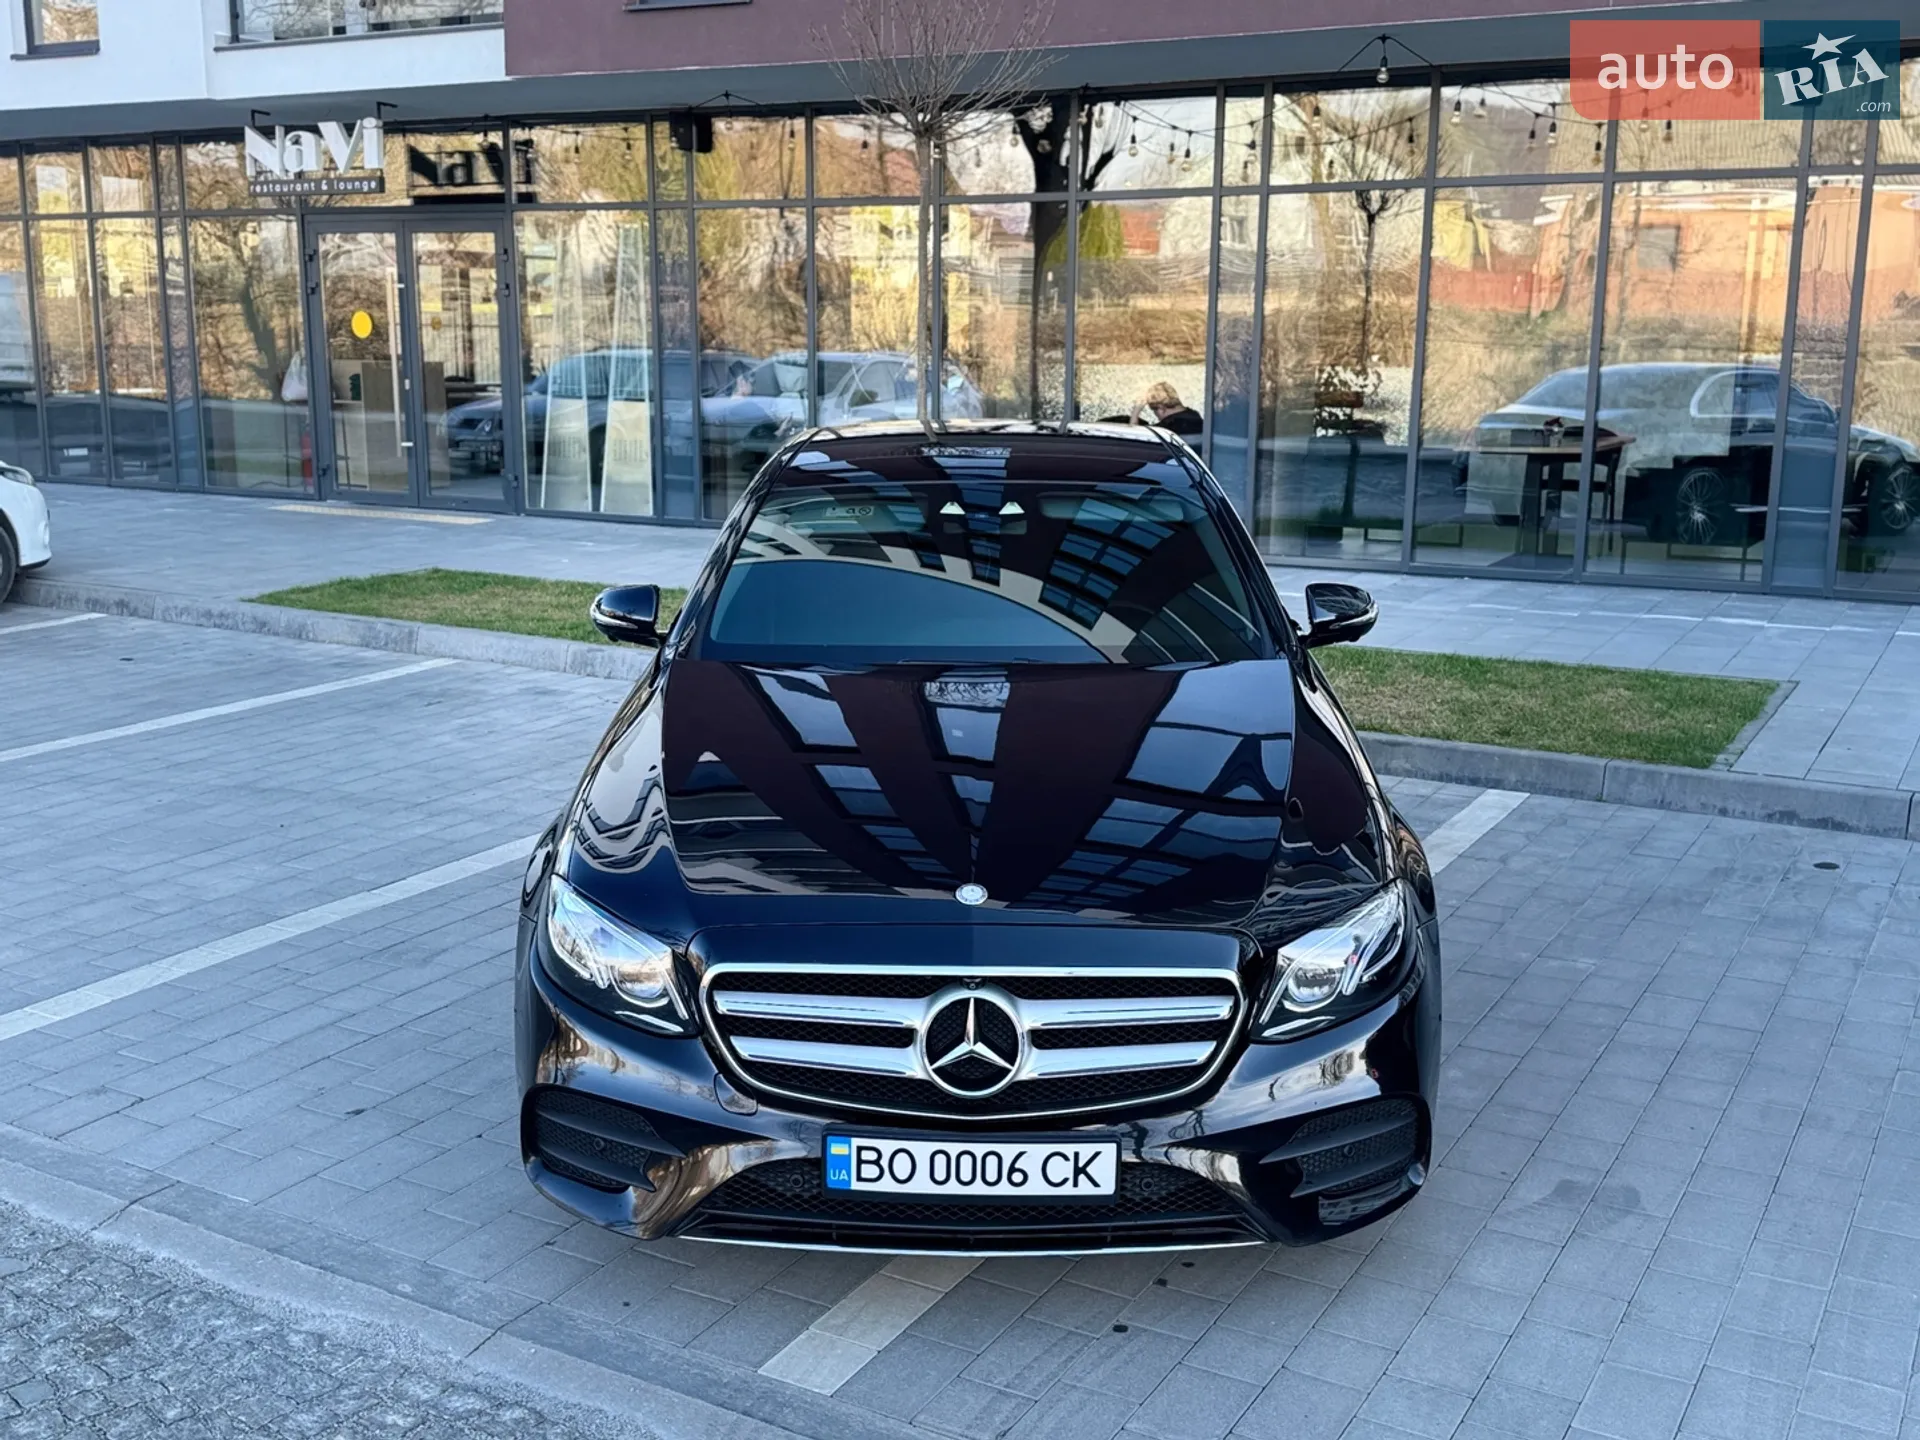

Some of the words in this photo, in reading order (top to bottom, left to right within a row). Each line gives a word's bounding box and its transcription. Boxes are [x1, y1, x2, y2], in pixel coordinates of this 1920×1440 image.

[244, 117, 384, 180] NaVi
[250, 181, 316, 194] restaurant
[321, 180, 329, 191] &
[333, 178, 377, 192] lounge
[830, 1169, 849, 1181] UA
[856, 1145, 917, 1185] BO
[929, 1149, 1029, 1188] 0006
[1041, 1150, 1102, 1188] CK
